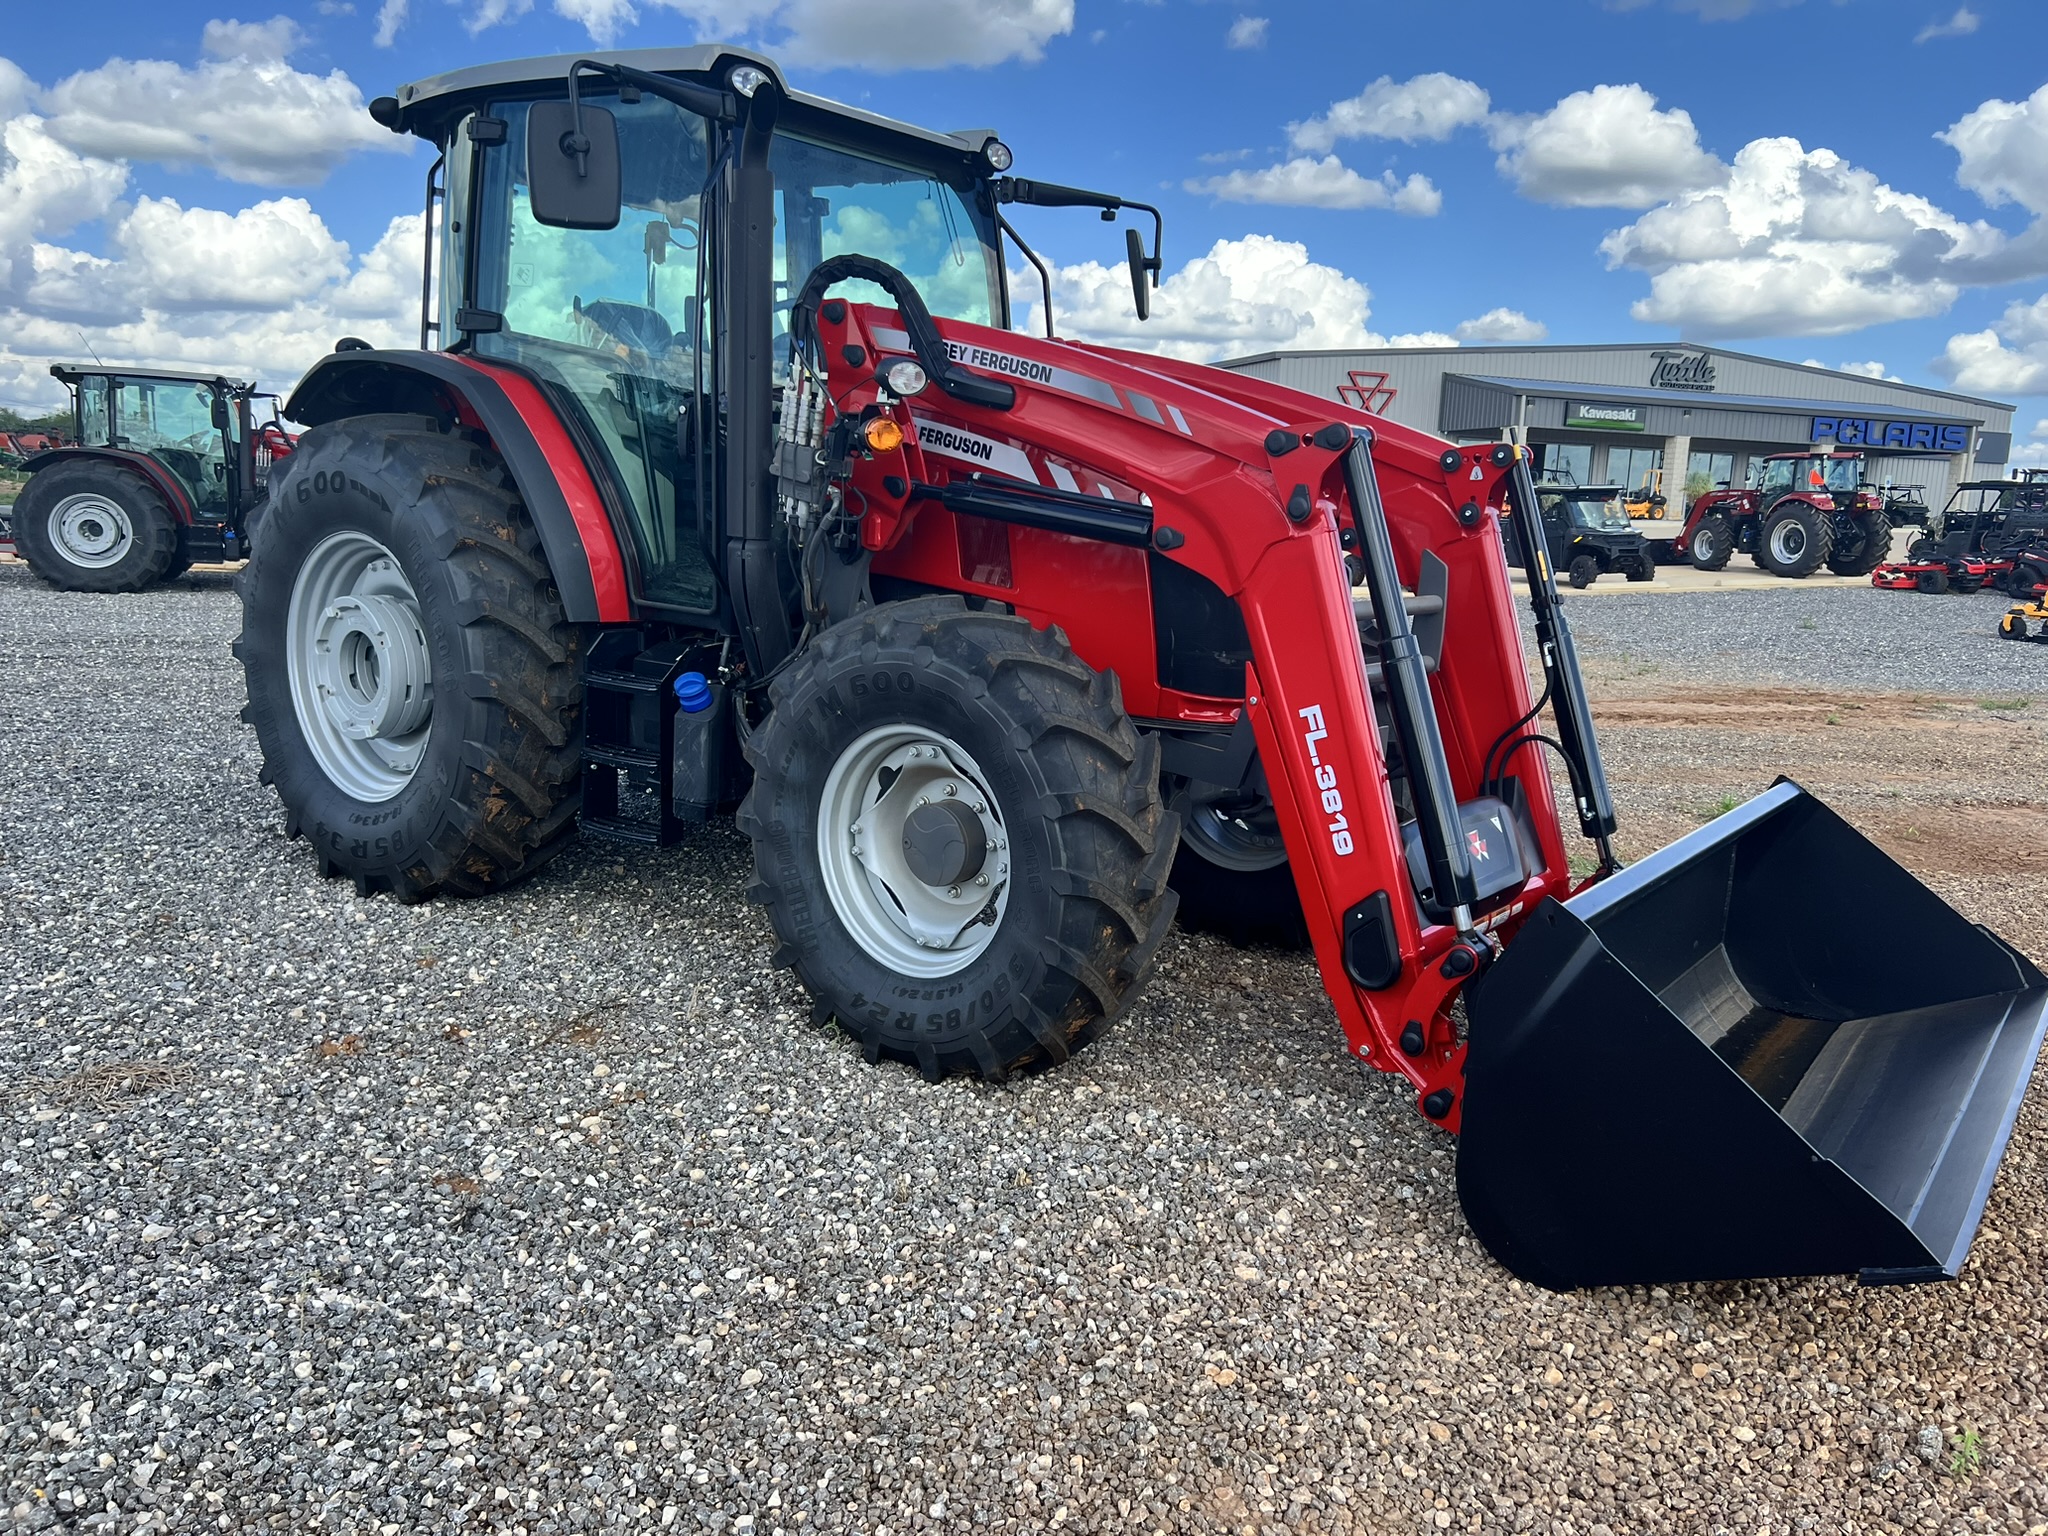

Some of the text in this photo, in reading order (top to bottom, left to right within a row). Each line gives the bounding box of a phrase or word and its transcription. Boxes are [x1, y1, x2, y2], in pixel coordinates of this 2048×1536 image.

[971, 347, 1053, 384] FERGUSON
[1650, 351, 1716, 387] Tuttle
[1579, 405, 1637, 421] Kawasaki
[918, 426, 993, 461] FERGUSON
[1811, 416, 1967, 450] POLARIS
[296, 470, 346, 505] 600
[795, 670, 916, 738] TM 600
[1298, 703, 1355, 857] FL.3819
[767, 819, 821, 959] TRELLEBORG
